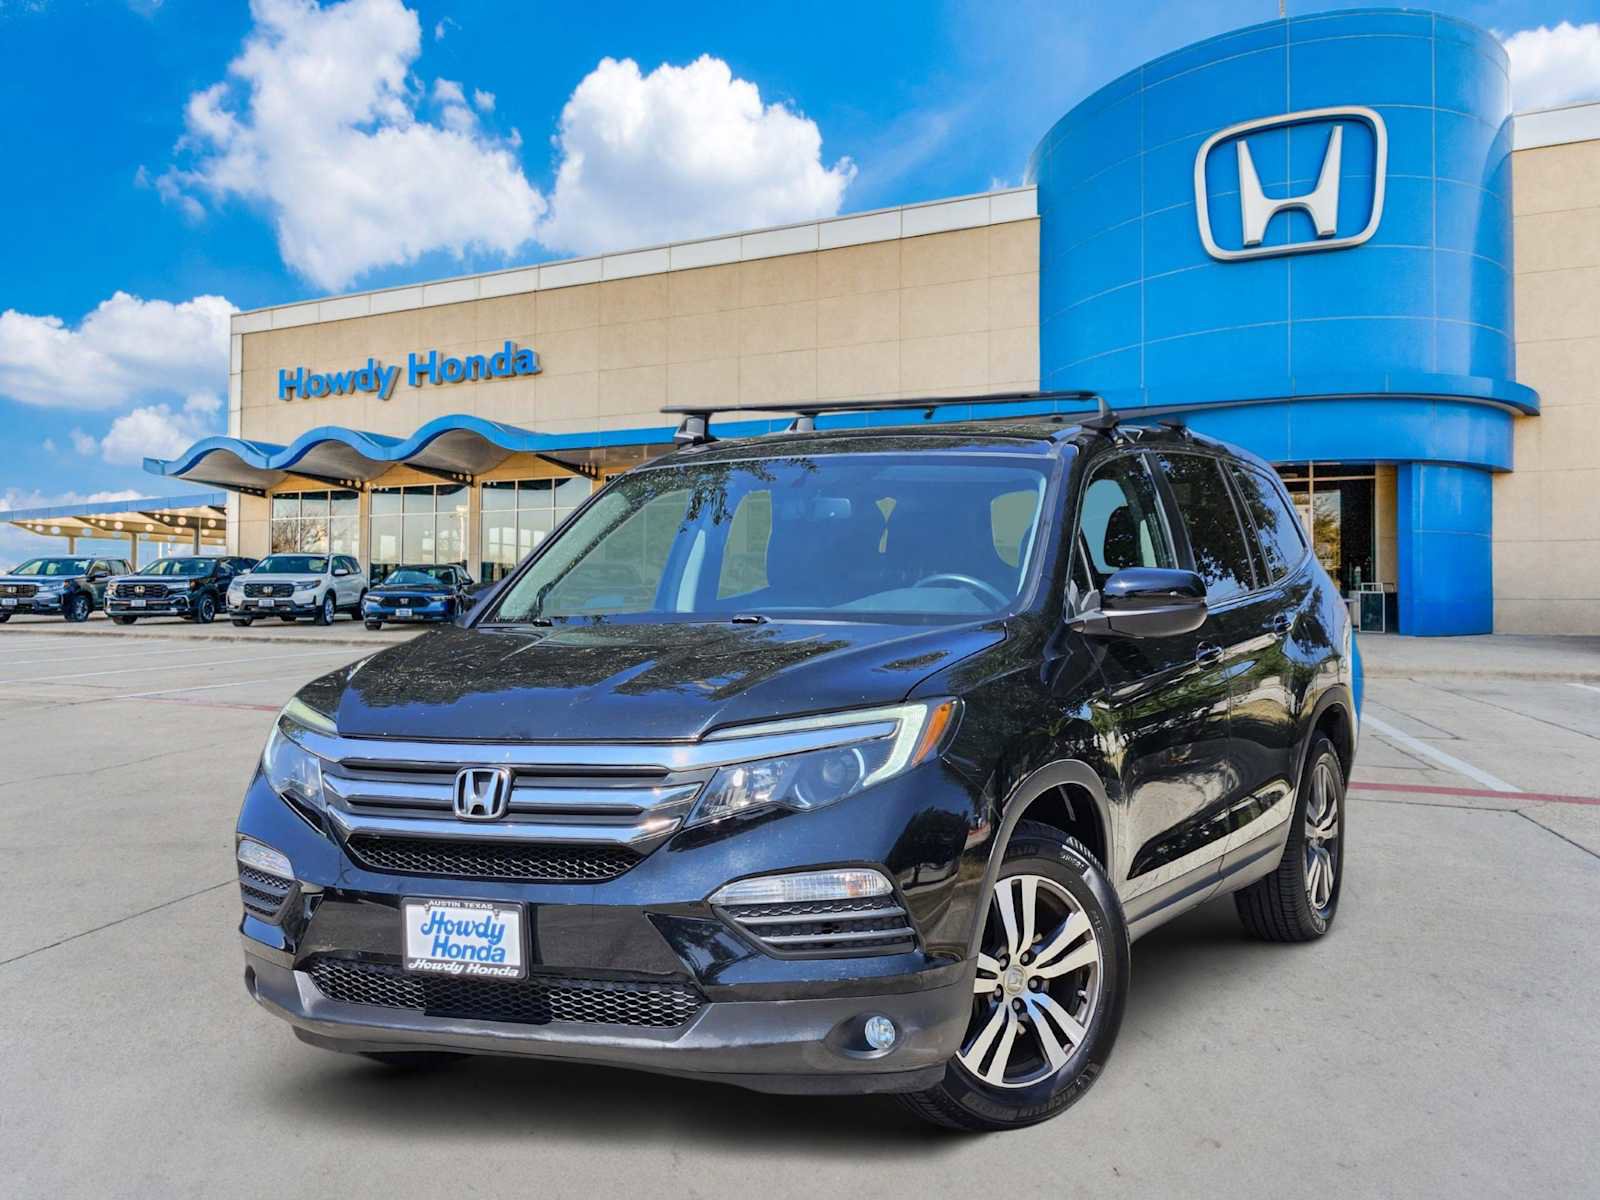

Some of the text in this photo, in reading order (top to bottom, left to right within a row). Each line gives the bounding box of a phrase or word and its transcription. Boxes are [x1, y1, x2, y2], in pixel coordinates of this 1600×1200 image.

[278, 341, 541, 400] Howdy Honda
[428, 900, 494, 910] AUSTIN TEXAS
[420, 911, 505, 945] Howdy
[431, 935, 506, 963] Honda
[408, 959, 519, 977] Howdy Honda
